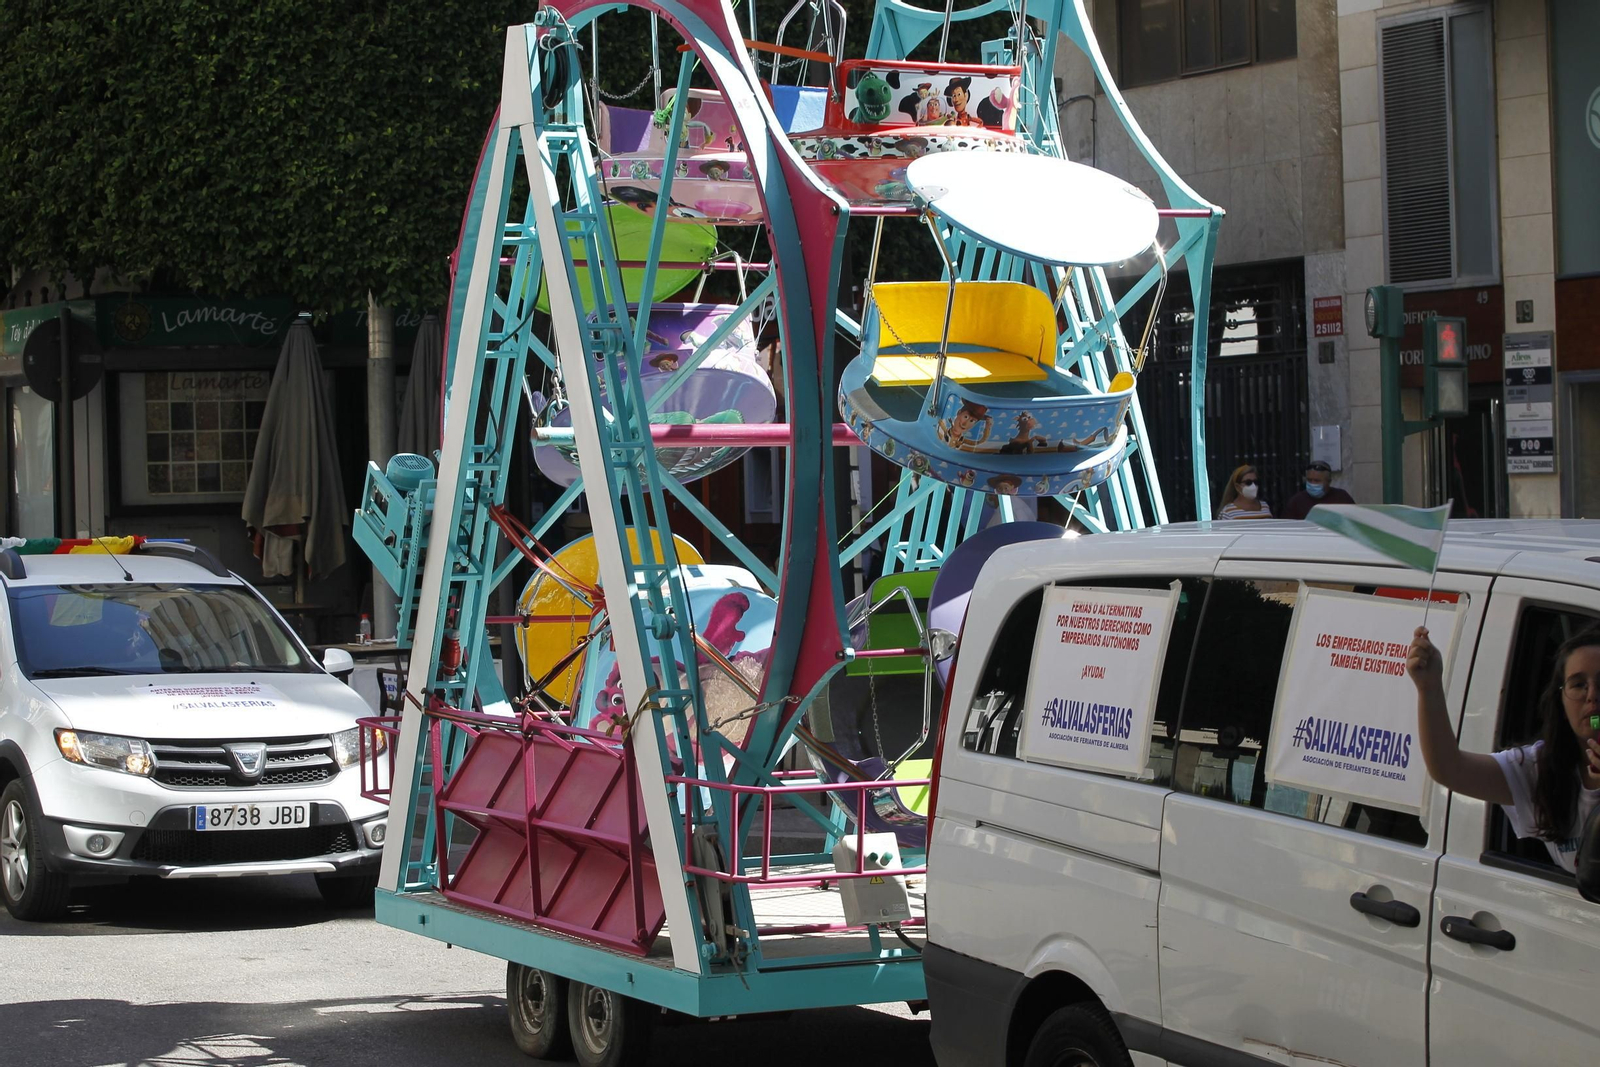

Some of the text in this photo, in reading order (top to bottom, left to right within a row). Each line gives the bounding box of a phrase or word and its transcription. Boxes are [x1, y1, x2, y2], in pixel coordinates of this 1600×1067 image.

[1476, 290, 1489, 304] 49
[161, 306, 278, 335] Lamarté
[1403, 310, 1438, 325] DIFICIO
[1316, 322, 1341, 335] 251112
[170, 372, 267, 391] Lamarté
[1071, 602, 1092, 614] FERIAS
[1098, 603, 1143, 618] ALTERNATIVAS
[1056, 614, 1152, 636] POR NUESTROS DERECHOS COMO
[1061, 630, 1140, 651] EMPRESARIOS AUTÓNOMOS
[1316, 633, 1411, 659] LOS EMPRESARIOS FERIA
[1081, 664, 1106, 680] ¡AYUDA!
[1330, 653, 1406, 677] TAMBIÉN EXISTIMOS
[1041, 697, 1133, 740] #SALVALASFERIAS
[1049, 732, 1073, 742] ASOCIACIÓN
[1079, 737, 1103, 747] FERIANTES
[1110, 742, 1129, 751] ALMERÍA
[1292, 716, 1412, 769] #SALVALASFERIAS
[1302, 755, 1406, 782] ASOCIACIÓN DE FERIANTES DE ALMERÍA
[210, 807, 261, 827] 8738
[269, 805, 305, 825] JBD
